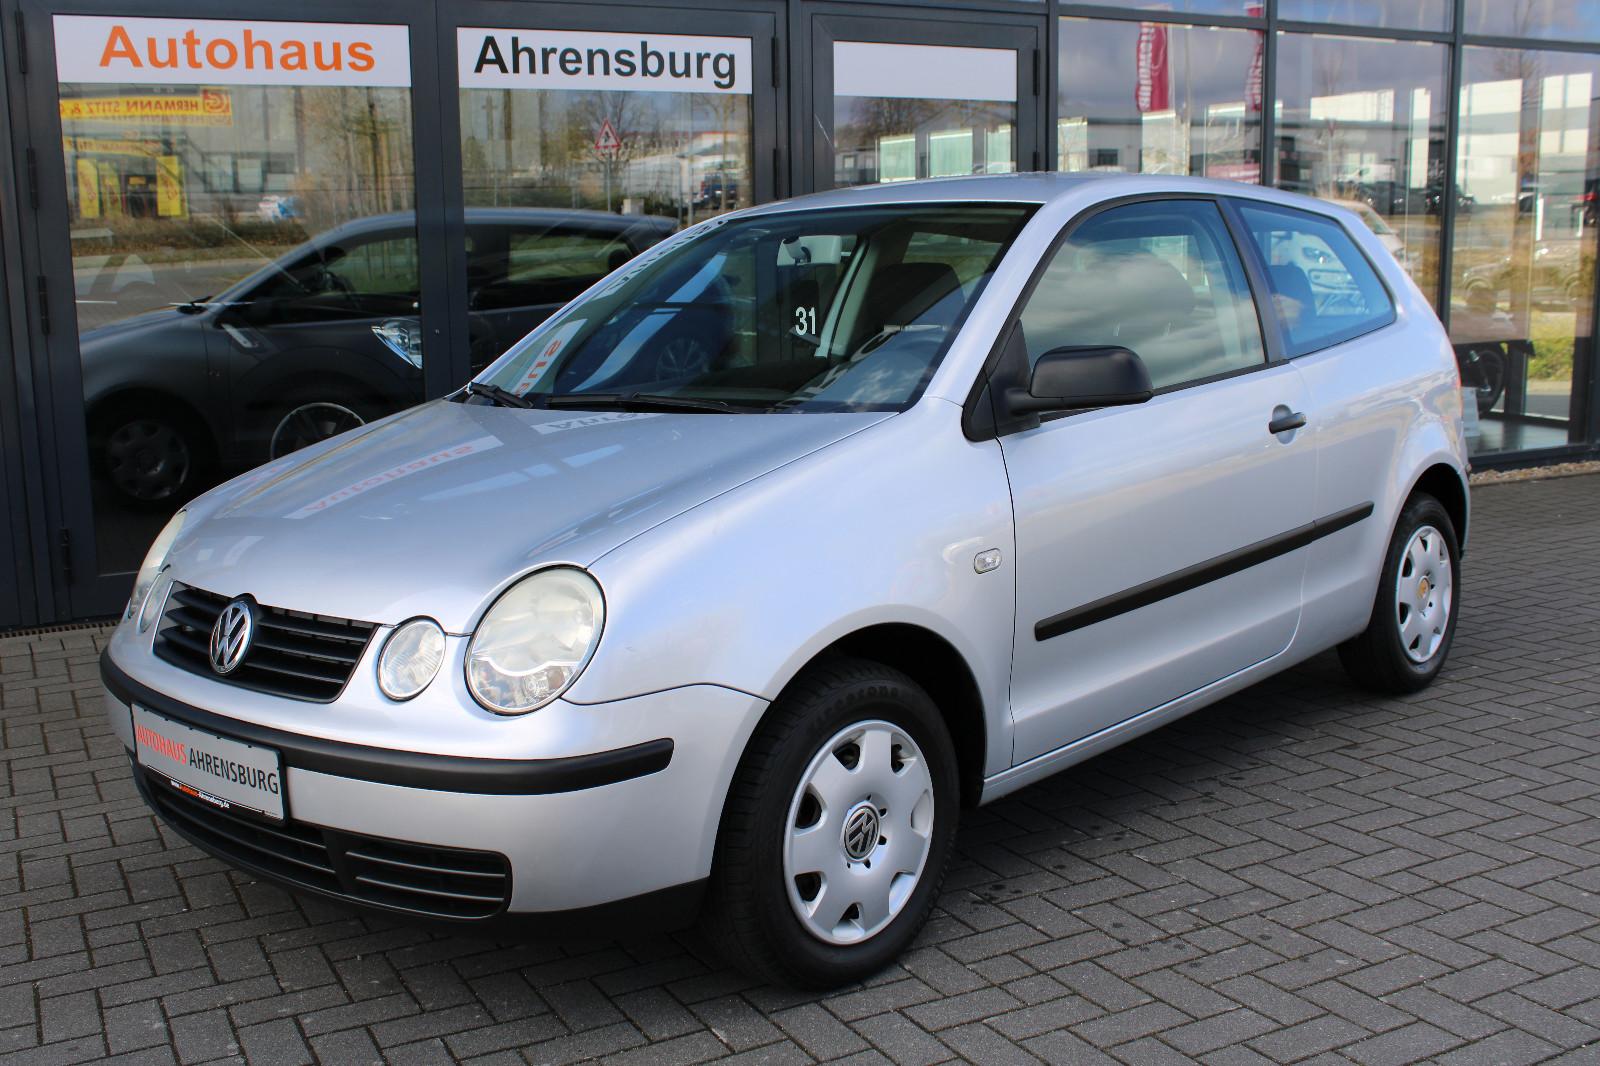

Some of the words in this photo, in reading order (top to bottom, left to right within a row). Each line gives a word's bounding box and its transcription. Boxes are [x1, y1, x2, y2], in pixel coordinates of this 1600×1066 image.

[99, 25, 376, 73] Autohaus
[473, 35, 738, 89] Ahrensburg
[795, 306, 816, 336] 31
[136, 724, 187, 765] AUTOHAUS
[189, 747, 279, 795] AHRENSBURG
